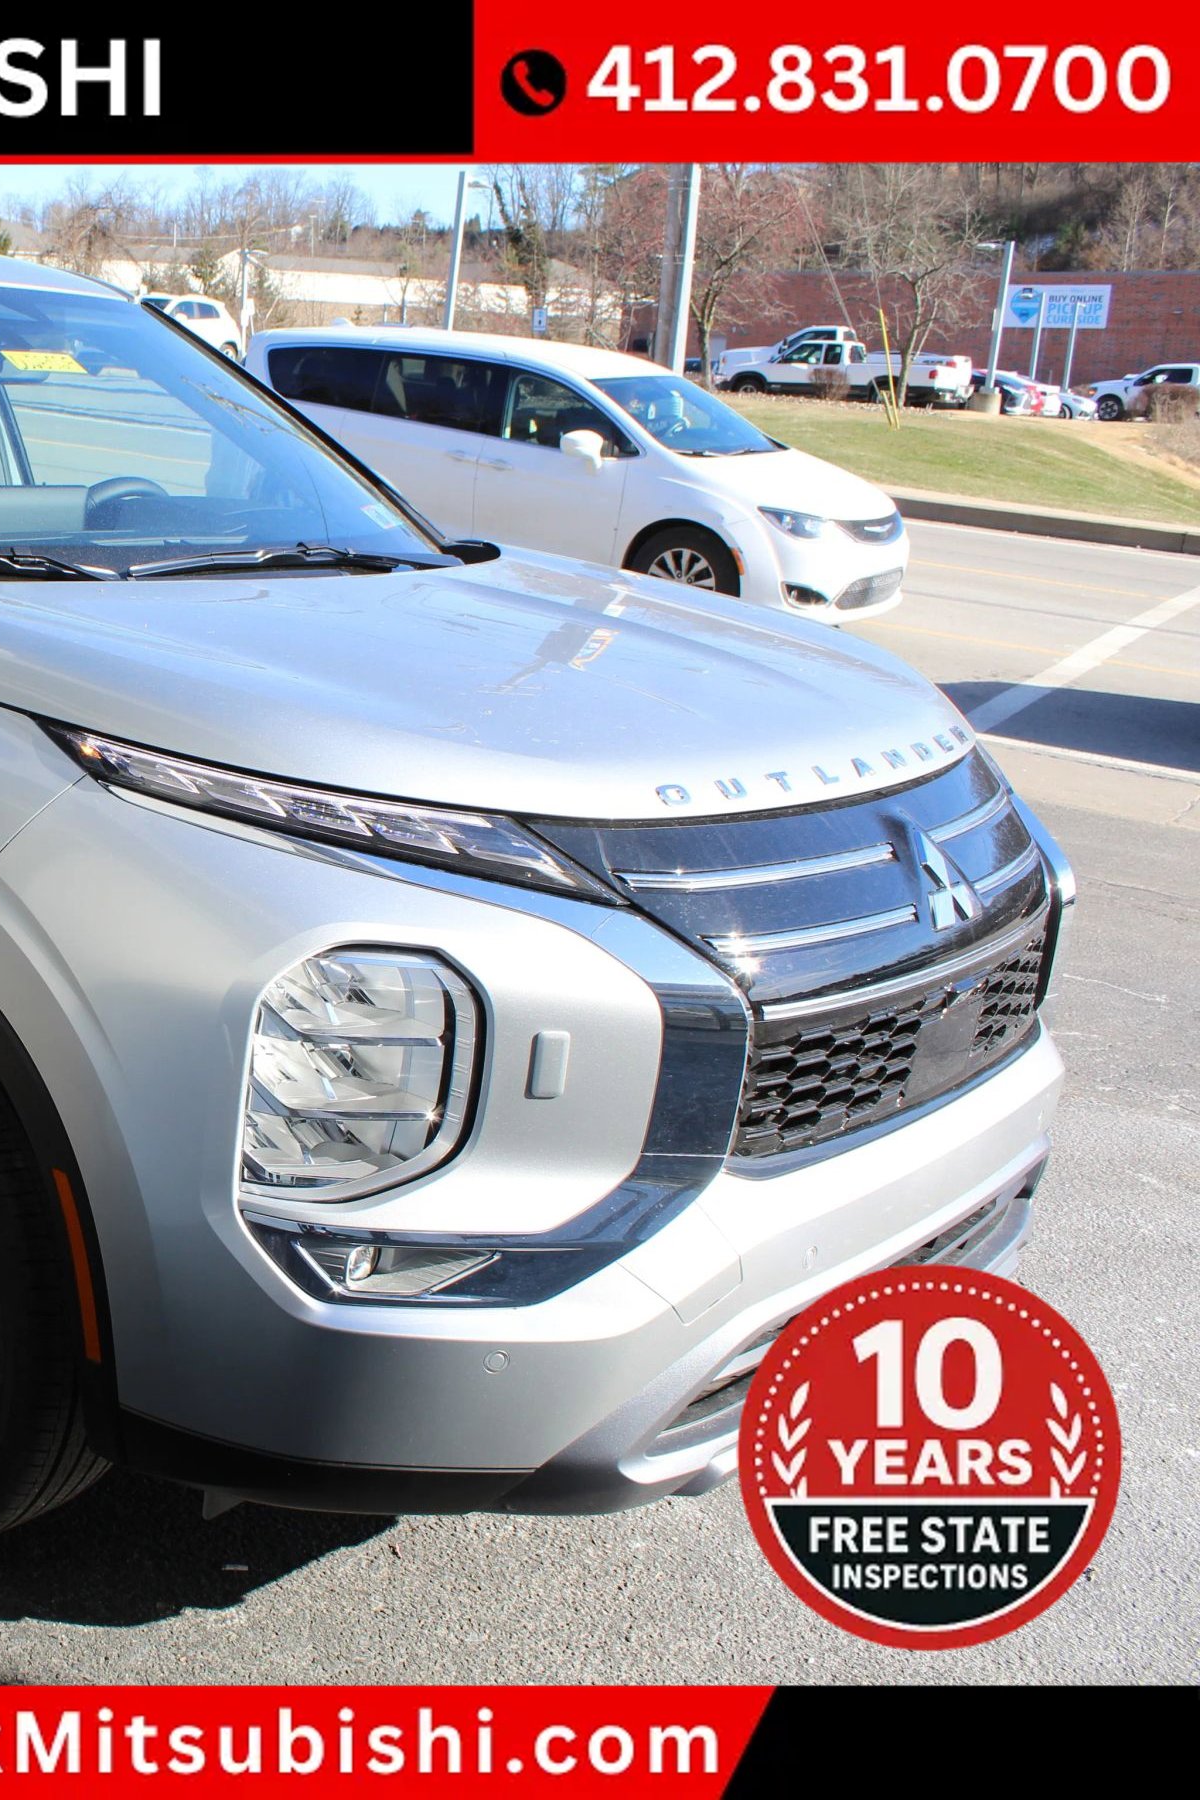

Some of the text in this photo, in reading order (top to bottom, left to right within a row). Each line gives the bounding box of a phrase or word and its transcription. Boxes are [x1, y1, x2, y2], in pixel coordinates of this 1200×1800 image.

[1049, 295, 1104, 303] BUY ONLINE
[654, 725, 970, 806] OUTLANDER
